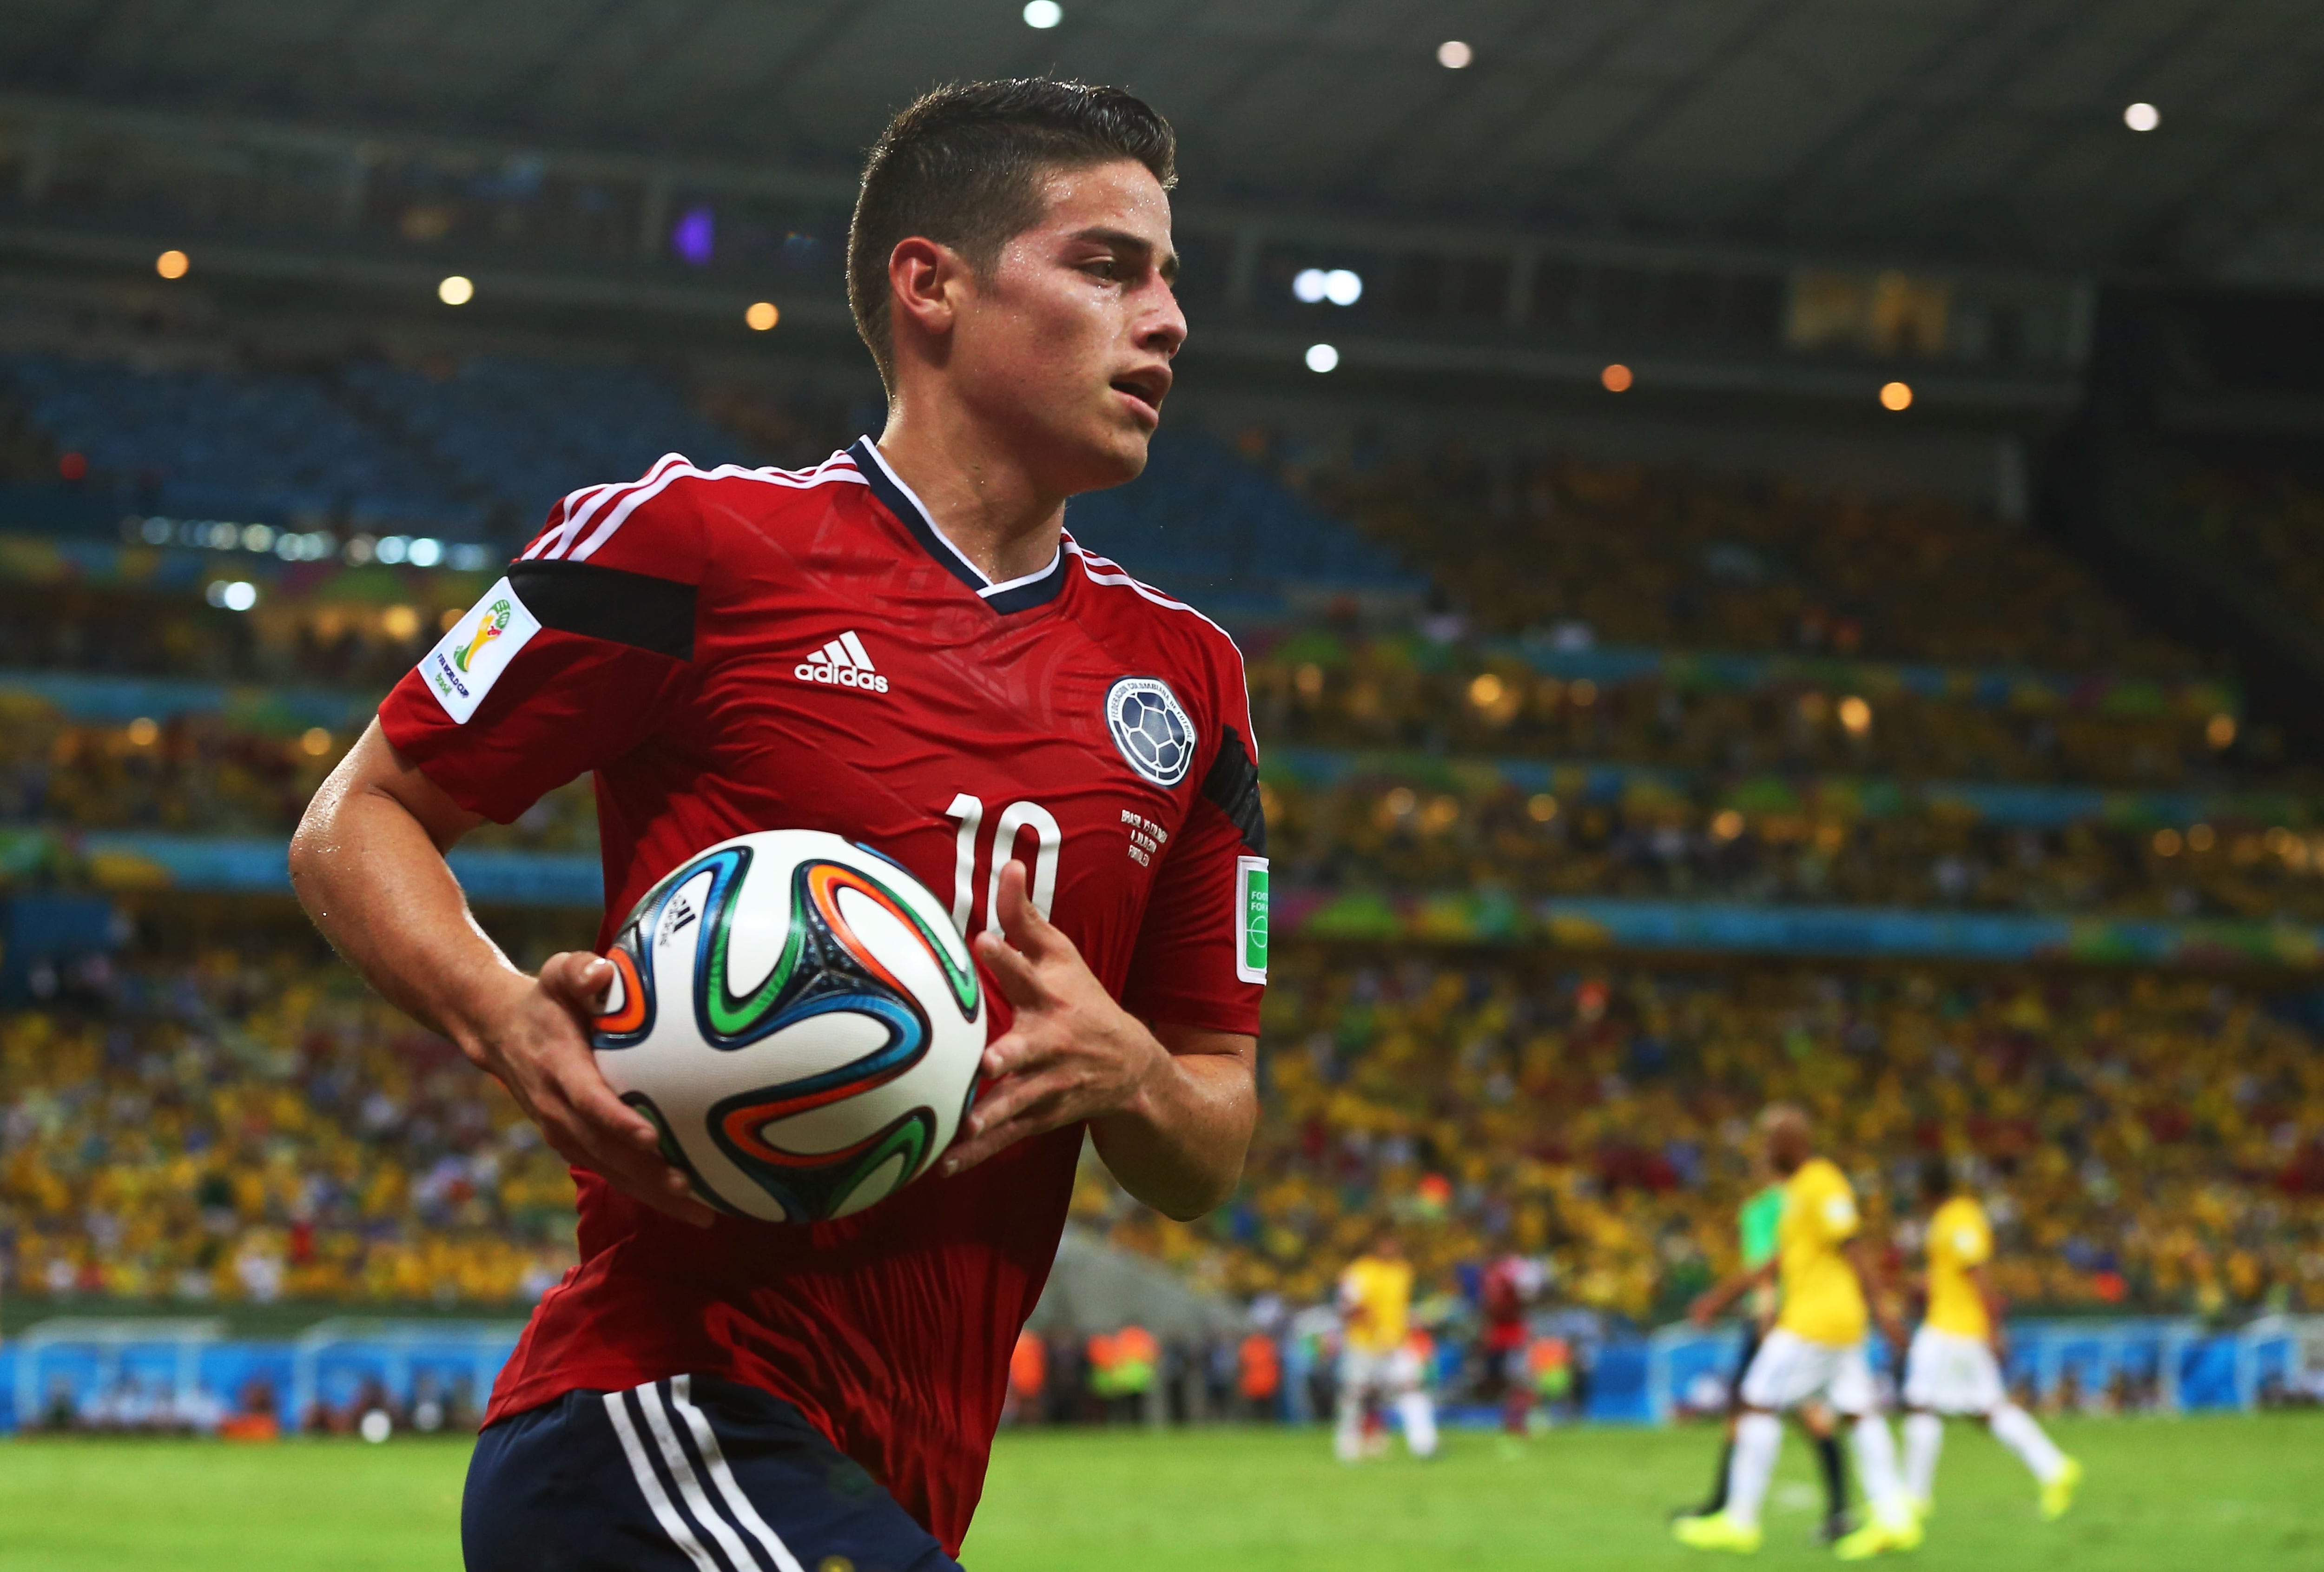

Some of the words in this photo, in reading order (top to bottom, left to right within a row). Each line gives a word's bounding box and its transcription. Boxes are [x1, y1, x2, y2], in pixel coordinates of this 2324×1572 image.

[443, 663, 459, 685] WORLD
[457, 683, 469, 698] CUP
[794, 662, 889, 693] adidas
[945, 793, 1062, 941] 10
